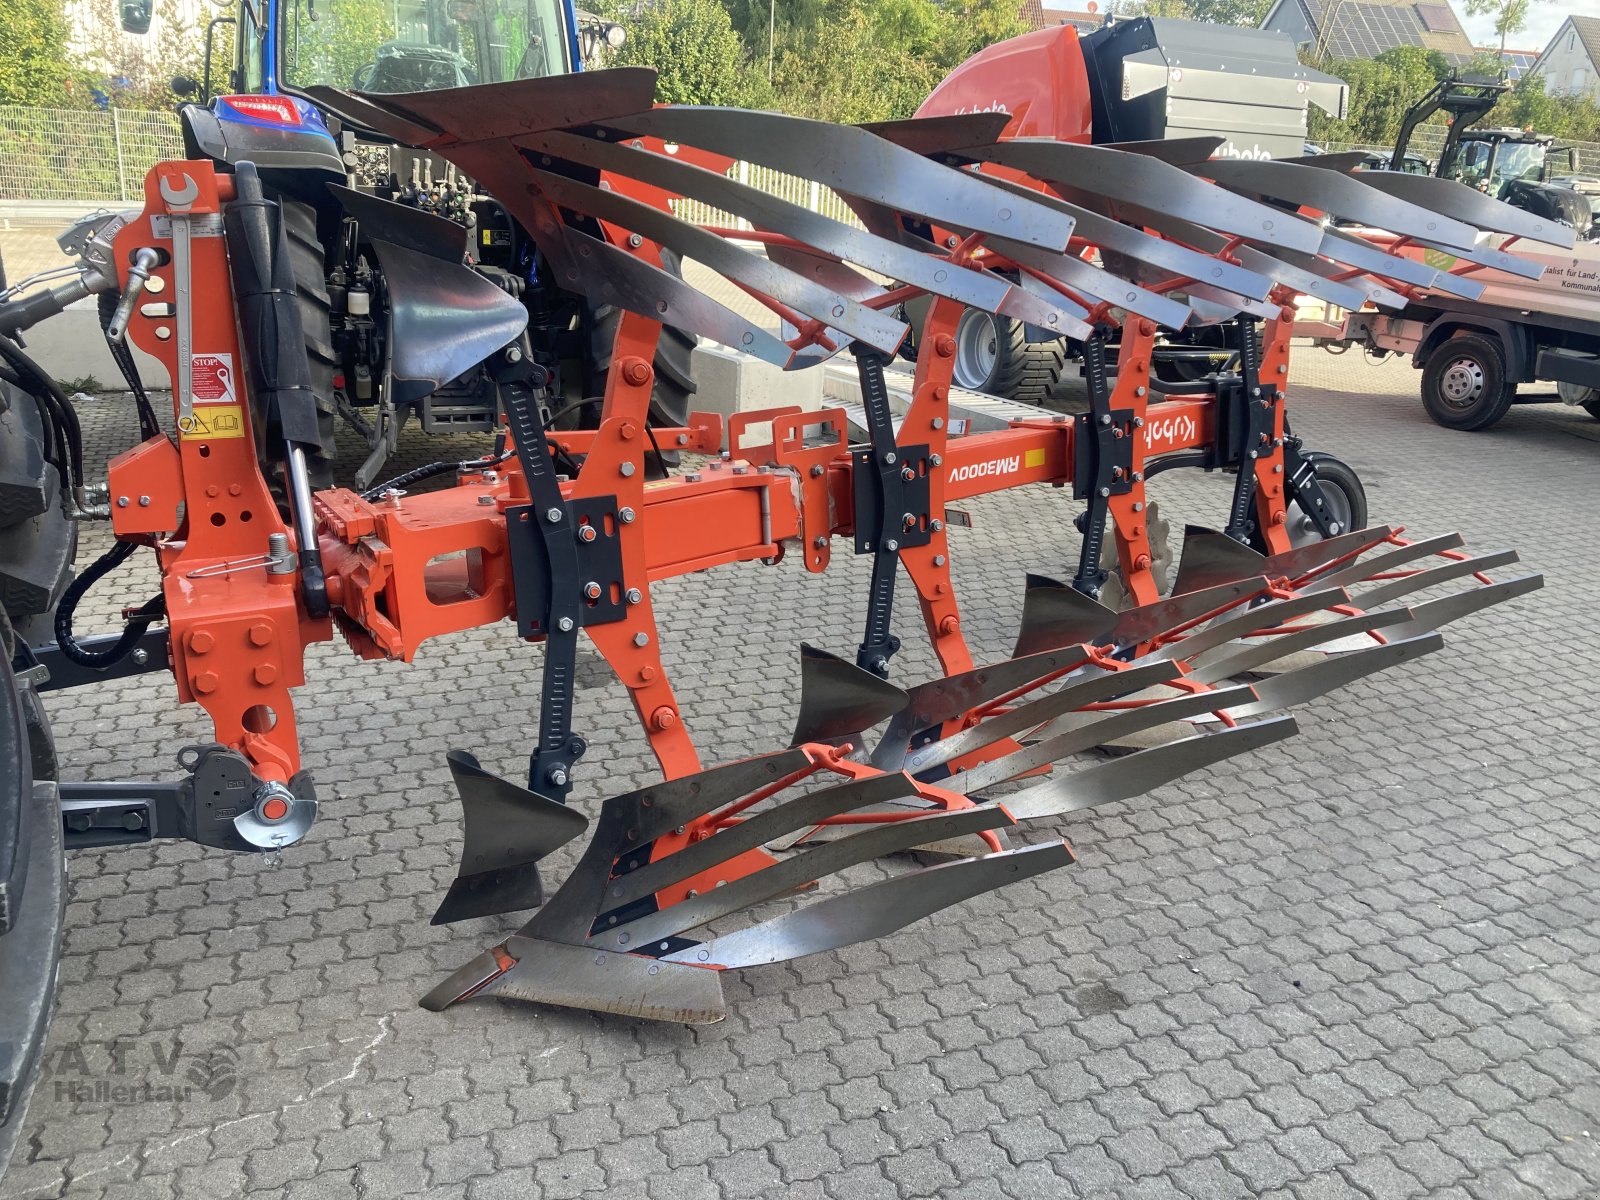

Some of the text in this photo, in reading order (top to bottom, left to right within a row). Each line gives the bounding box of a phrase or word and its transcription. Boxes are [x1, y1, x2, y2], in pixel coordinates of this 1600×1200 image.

[193, 358, 219, 367] STOP!
[1143, 415, 1196, 449] Kubot
[948, 455, 1020, 483] RM3000V
